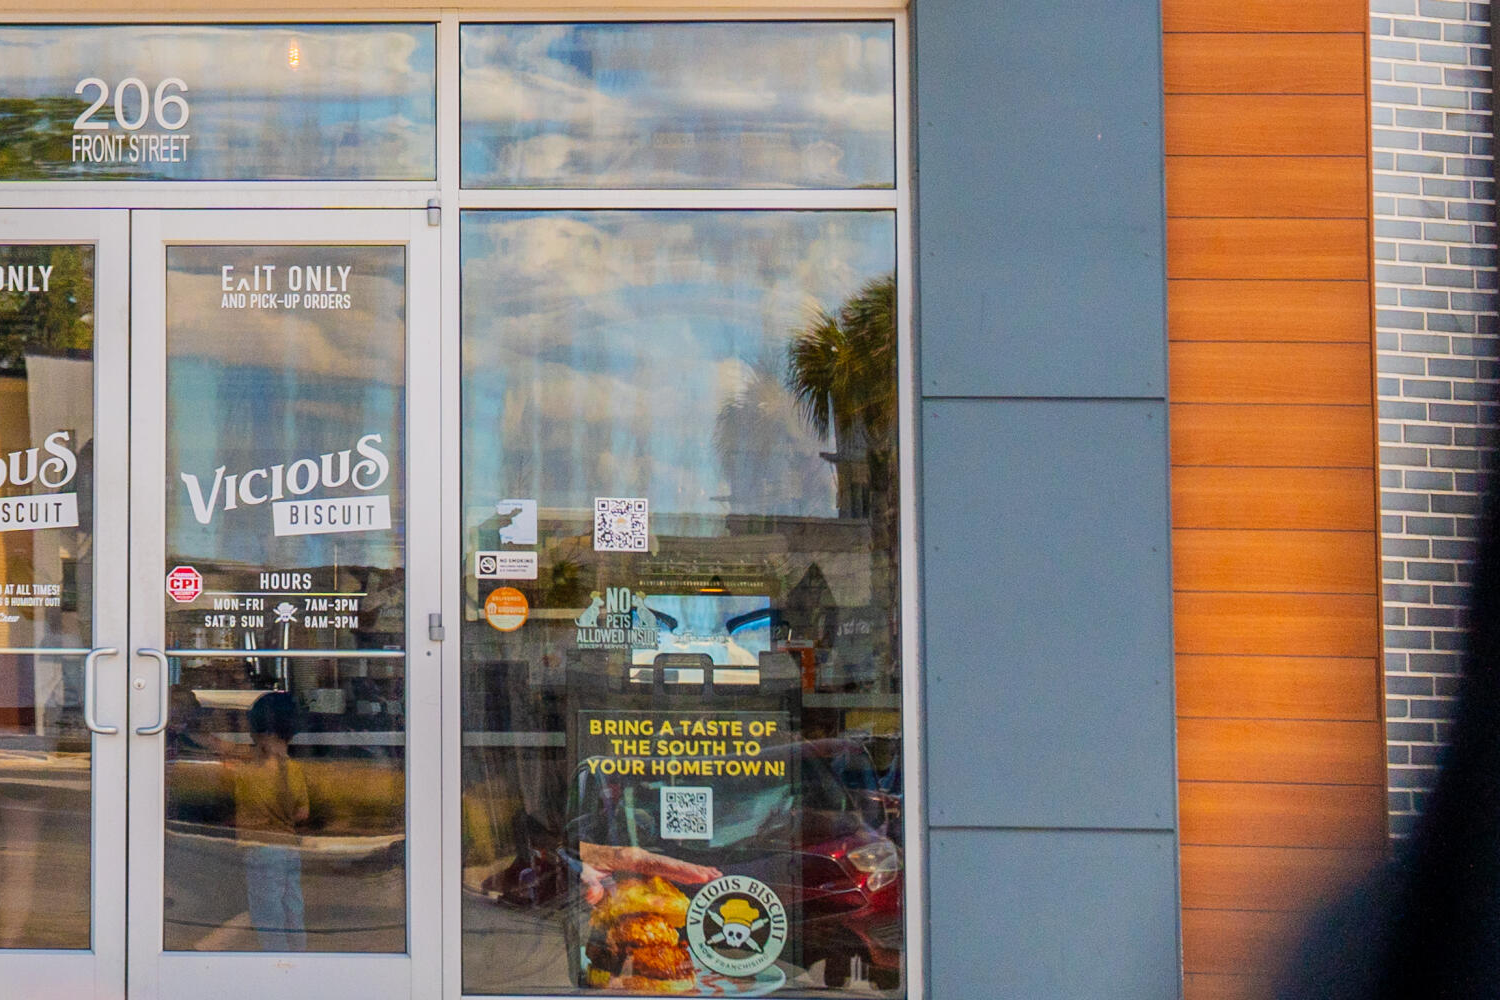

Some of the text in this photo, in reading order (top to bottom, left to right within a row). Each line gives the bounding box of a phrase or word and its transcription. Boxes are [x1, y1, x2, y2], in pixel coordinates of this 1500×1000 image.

[72, 77, 190, 131] 206
[71, 134, 191, 163] FRONT STREET
[288, 265, 352, 292] ONLY
[220, 293, 352, 309] AND PICK-UP ORDERS
[180, 433, 390, 525] VICIOUS
[288, 504, 376, 526] BISCUIT
[4, 583, 15, 596] AT
[16, 583, 31, 596] ALL
[32, 583, 61, 596] TIMES!
[169, 578, 199, 590] CPI
[259, 572, 313, 590] HOURS
[10, 596, 44, 607] HUMIDITY
[213, 598, 265, 611] MON-FRI
[304, 598, 359, 612] 7AM-3PM
[605, 586, 631, 614] NO
[204, 615, 265, 628] SAT & SUN
[304, 615, 359, 628] 8AM-3PM
[606, 614, 631, 629] PETS
[576, 628, 660, 644] ALLOWED INSIDE
[589, 719, 778, 737] BRING A TASTE OF
[610, 739, 761, 757] THE SOUTH TO
[586, 758, 786, 777] YOUR HOMETOWN!
[689, 878, 785, 944] VICIOUS BISCUIT
